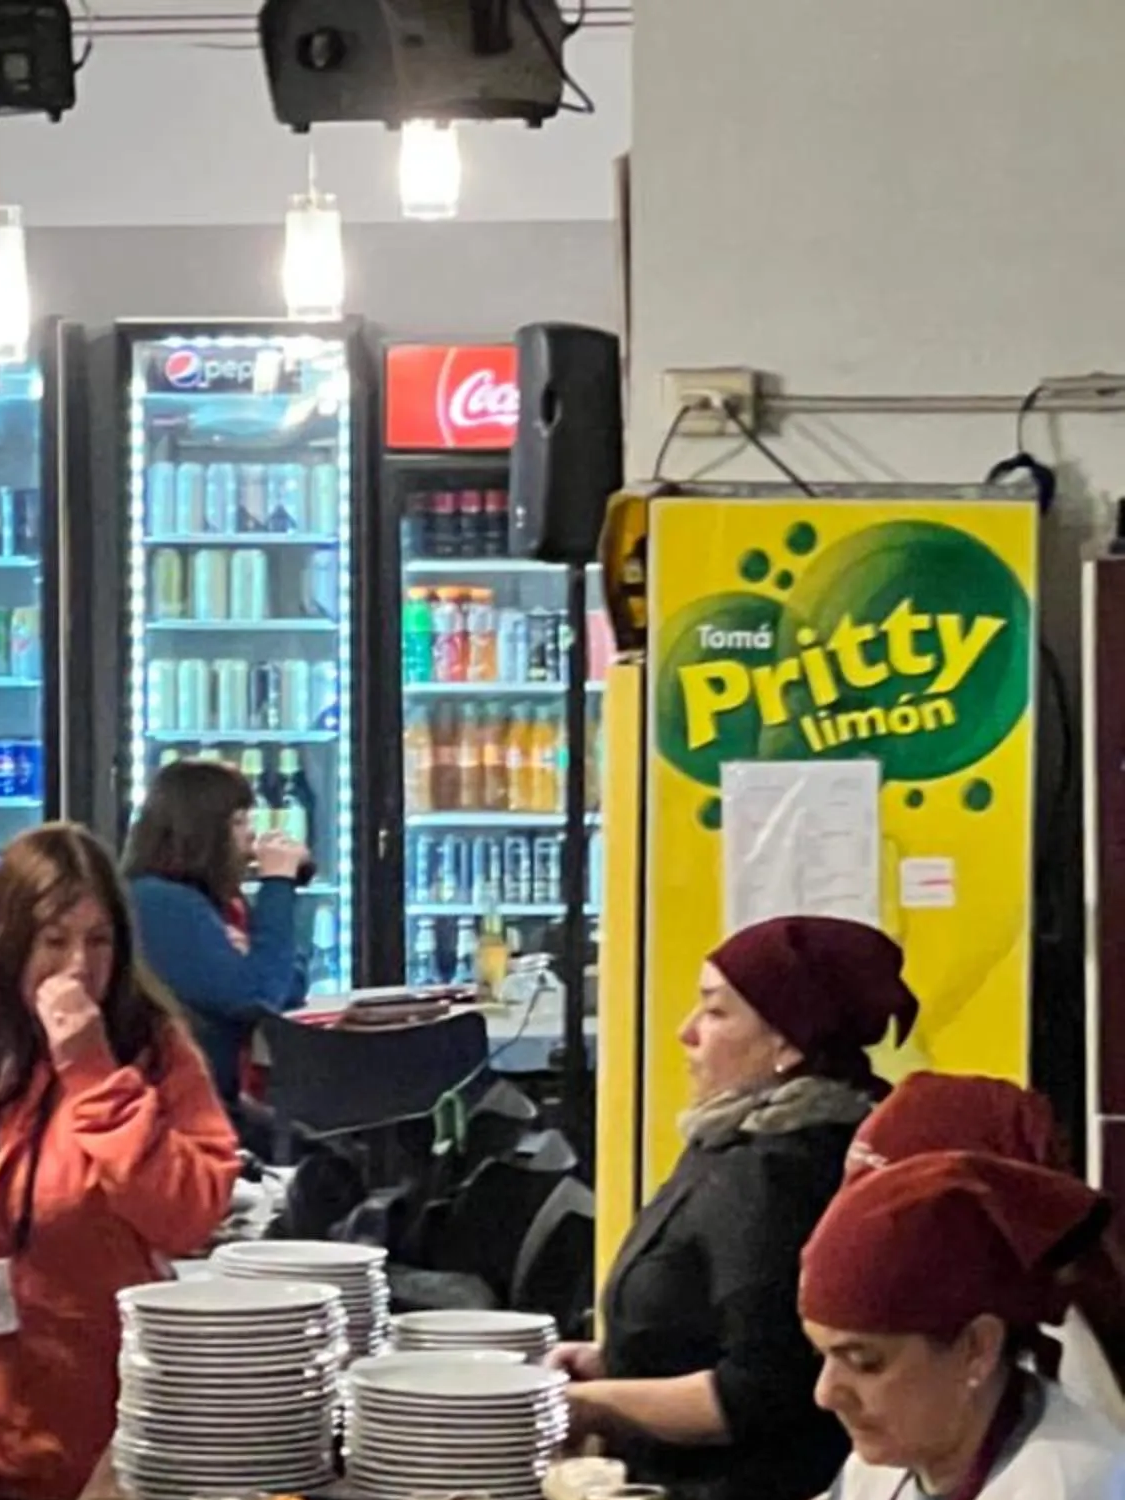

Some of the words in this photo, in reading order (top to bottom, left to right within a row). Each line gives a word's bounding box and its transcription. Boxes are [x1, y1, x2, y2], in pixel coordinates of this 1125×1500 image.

[205, 359, 257, 383] pep
[697, 624, 772, 649] Tomá
[678, 598, 1007, 750] Pritty
[801, 693, 956, 752] limón
